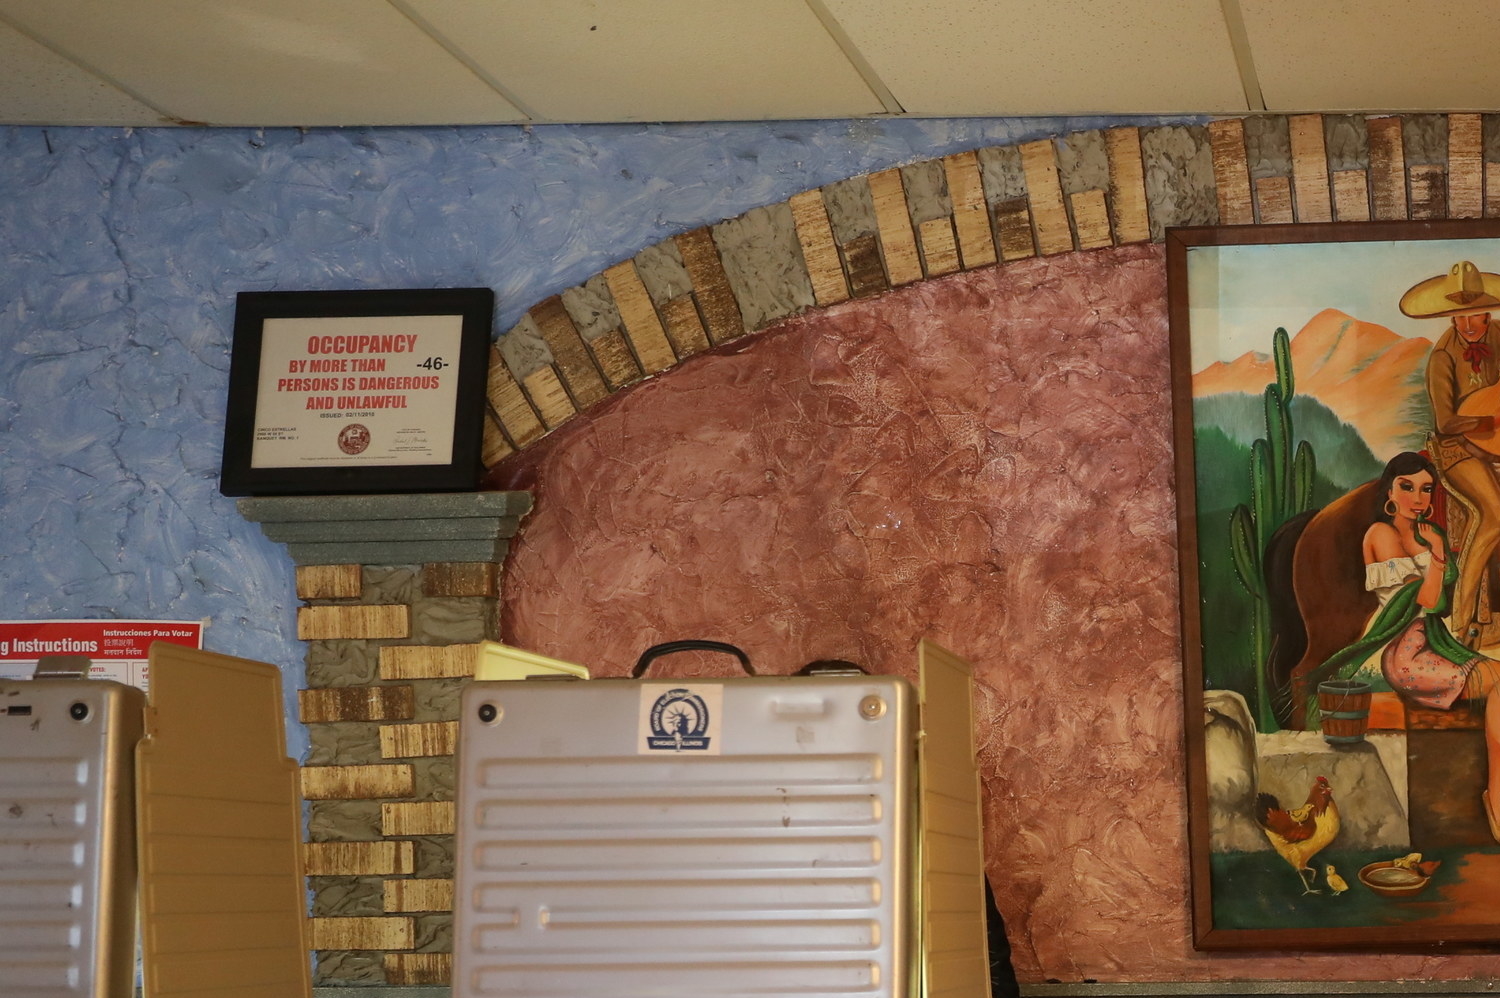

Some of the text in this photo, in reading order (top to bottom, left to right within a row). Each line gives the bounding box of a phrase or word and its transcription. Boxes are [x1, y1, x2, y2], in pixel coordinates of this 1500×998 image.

[307, 334, 418, 355] OCCUPANCY
[289, 358, 386, 373] BY MORE THAN
[416, 357, 449, 371] -46-
[277, 376, 440, 392] PERSONS IS DANGEROUS
[305, 395, 408, 410] AND UNLAWFUL
[103, 629, 152, 637] Instrucciones
[13, 637, 98, 652] Instructions
